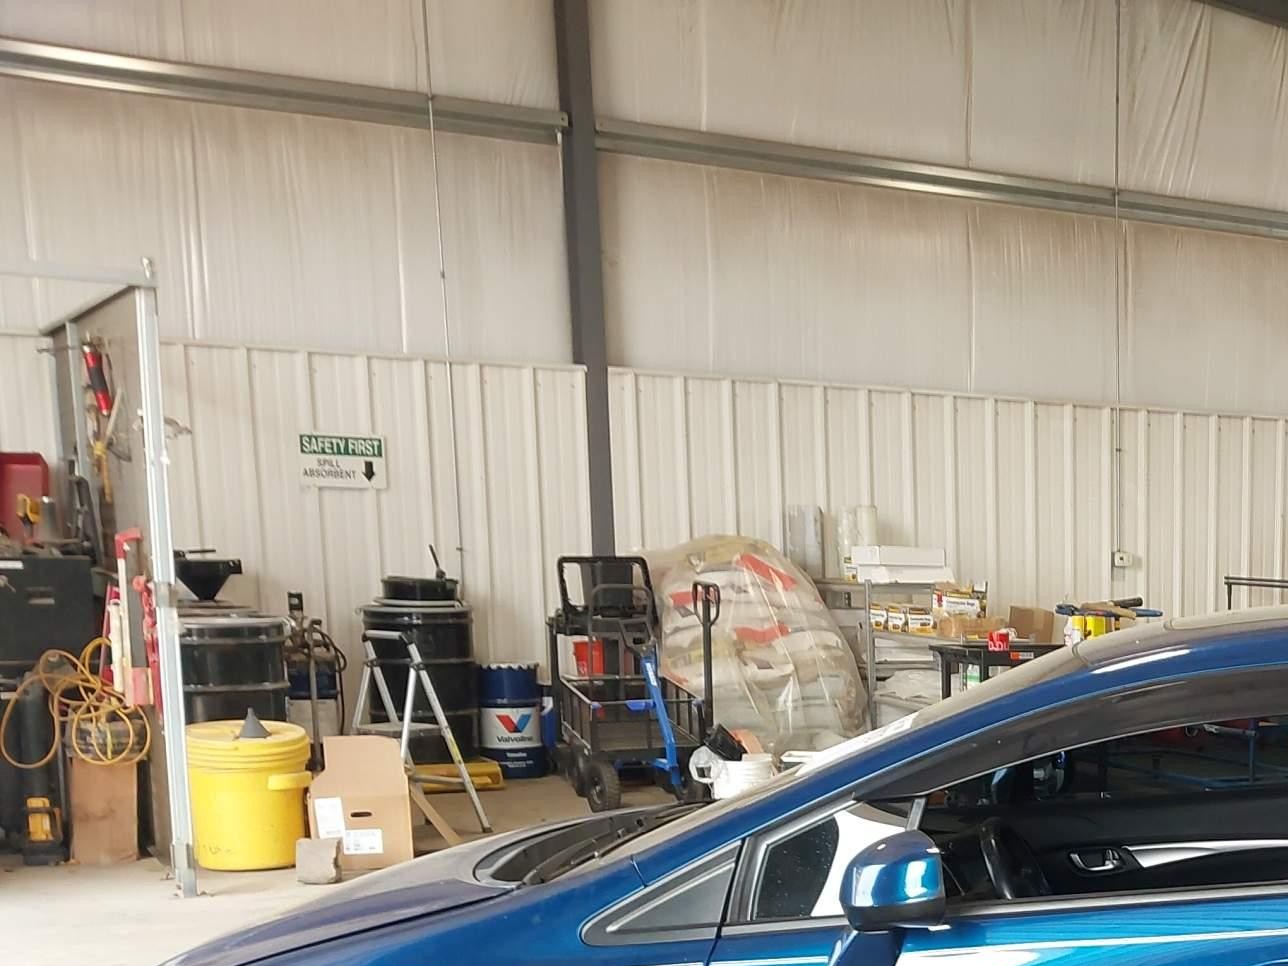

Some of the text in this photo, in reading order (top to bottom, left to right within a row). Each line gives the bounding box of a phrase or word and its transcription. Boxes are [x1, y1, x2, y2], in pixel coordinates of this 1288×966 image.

[301, 435, 380, 455] SAFETY FIRST
[316, 458, 341, 468] SPILL
[302, 467, 357, 480] ABSORBENT
[496, 735, 534, 743] Valvoline
